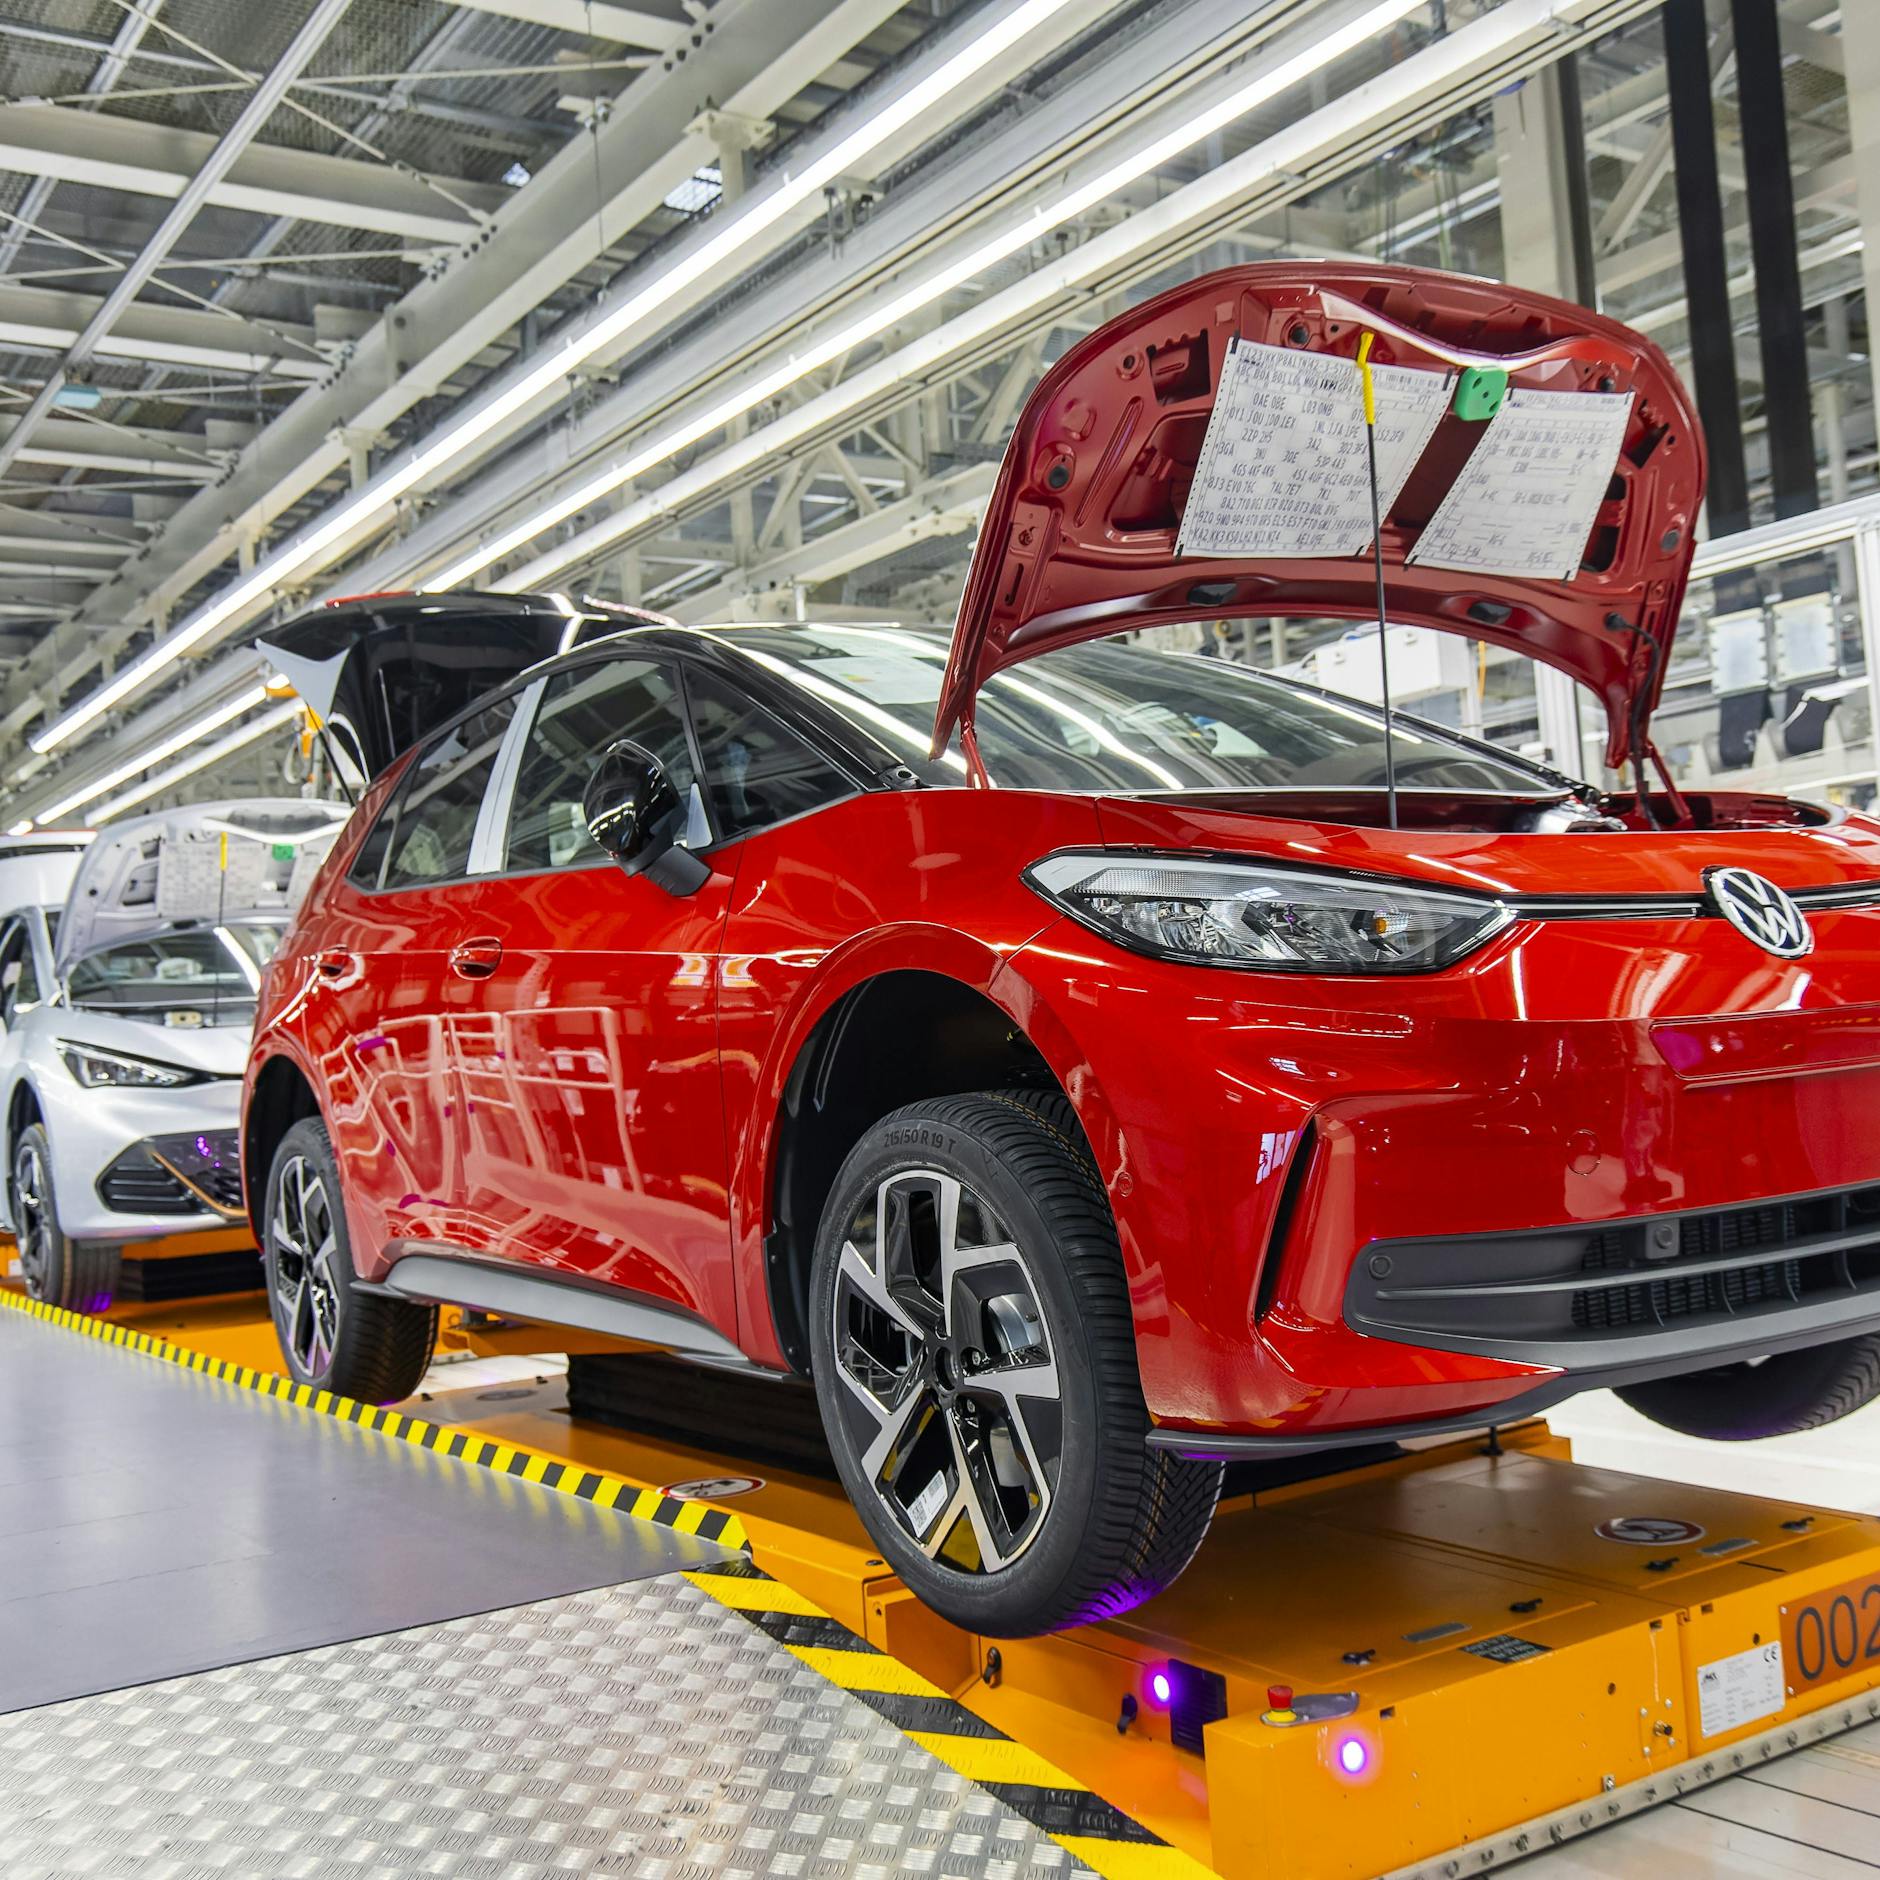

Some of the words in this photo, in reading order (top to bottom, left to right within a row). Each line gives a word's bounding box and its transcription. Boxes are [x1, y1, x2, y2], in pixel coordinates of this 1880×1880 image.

[884, 1128, 919, 1148] 215/50
[921, 1130, 929, 1146] R
[932, 1132, 944, 1149] 19
[948, 1138, 957, 1154] T
